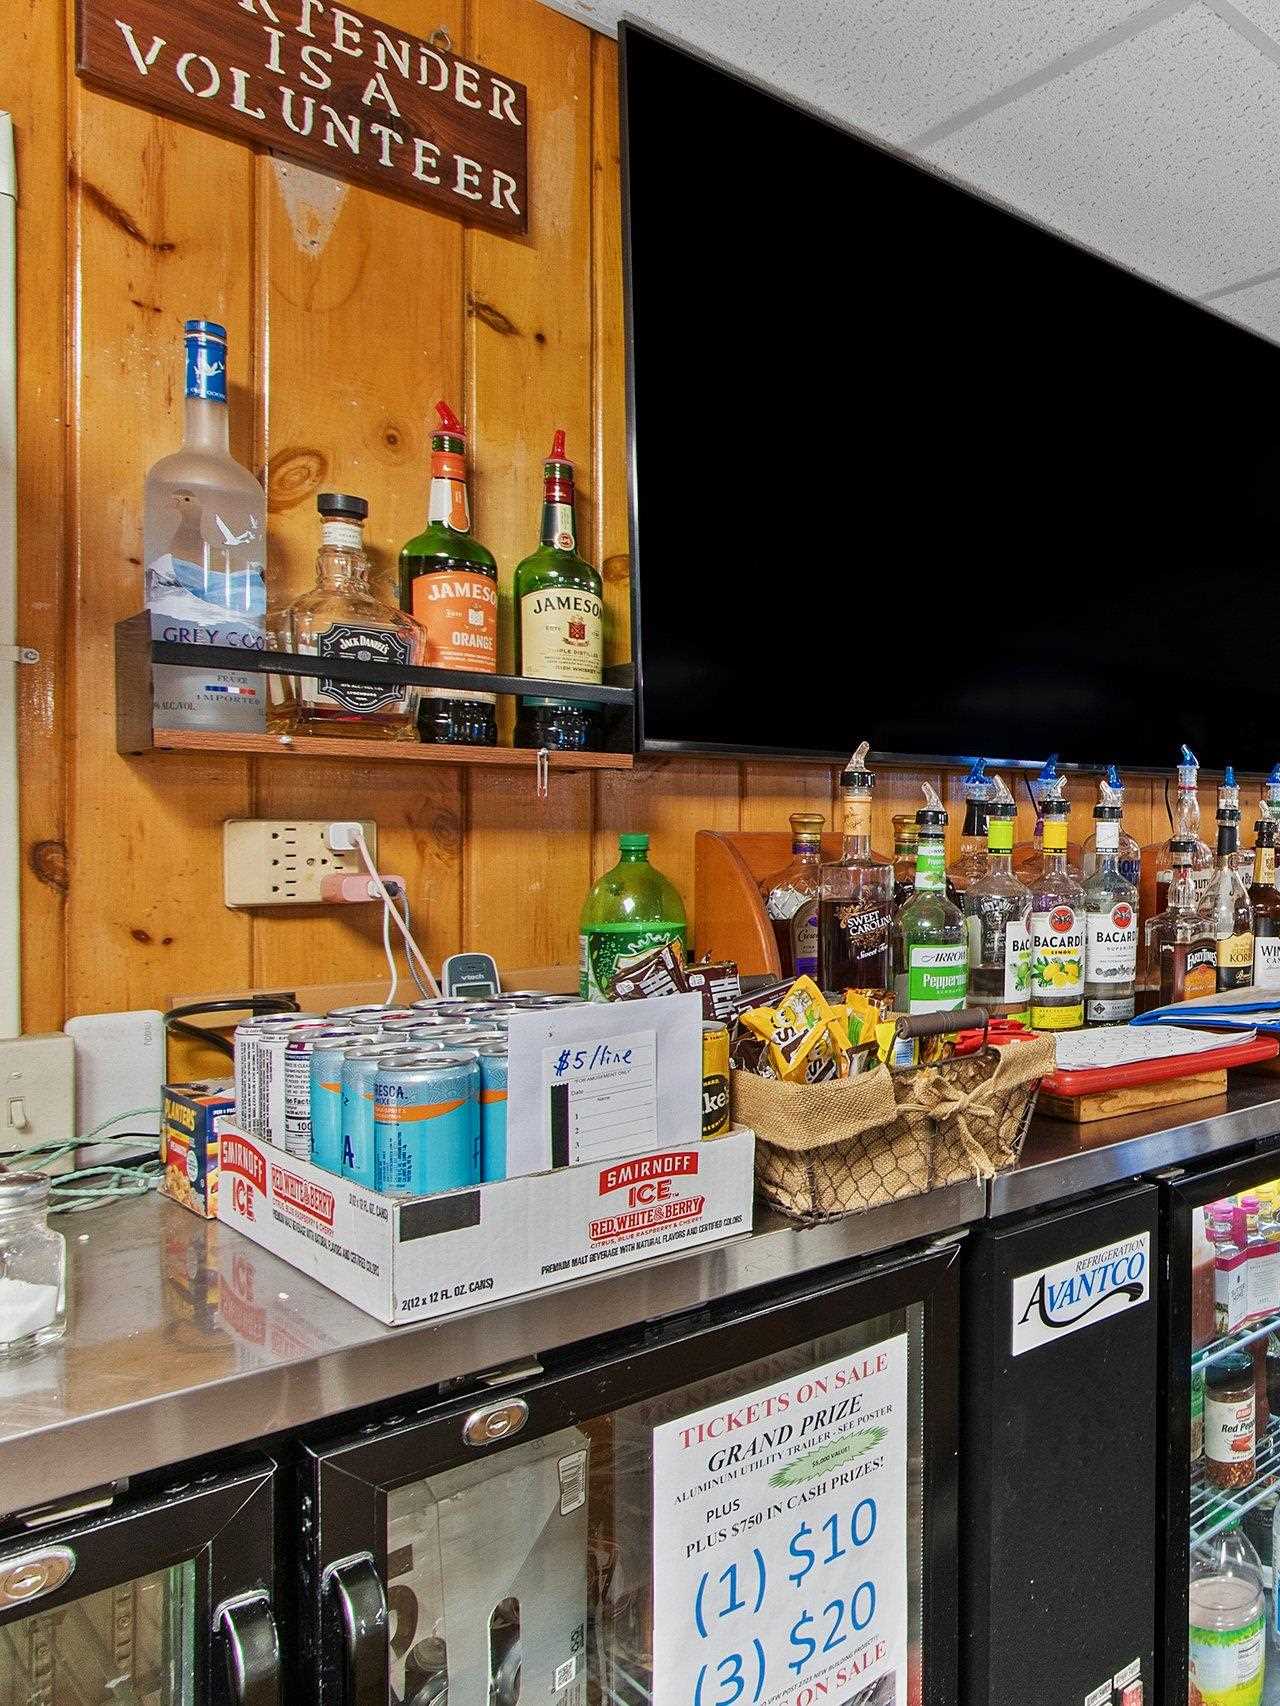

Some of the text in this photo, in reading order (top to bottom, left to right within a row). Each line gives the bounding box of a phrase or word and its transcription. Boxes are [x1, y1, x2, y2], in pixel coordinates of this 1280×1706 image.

[263, 26, 400, 117] IS A
[115, 19, 521, 216] VOLUNTEER
[163, 626, 219, 643] GREY
[340, 636, 390, 655] JACK DANIEL'S
[452, 632, 493, 650] ORANGE
[848, 912, 880, 927] SWEET
[1034, 931, 1083, 948] BACARDÍ
[223, 1141, 263, 1184] SMIRNOFF
[607, 1156, 691, 1187] SMIRNOFF
[232, 1177, 257, 1222] ICE
[628, 1179, 672, 1208] ICE
[616, 1210, 655, 1231] WHITE
[665, 1198, 702, 1217] BERRY
[636, 1224, 673, 1238] RASPBERRY
[541, 1213, 743, 1275] PREMIUM MALT BEVERAGE WITH NATURAL FLAVORS AND CERTIFIED COLORS
[1075, 1238, 1146, 1272] REFRIGERATION
[429, 1292, 438, 1303] 12
[440, 1289, 453, 1300] FL.
[454, 1285, 468, 1297] OZ.
[469, 1277, 494, 1294] CANS)
[1018, 1252, 1145, 1328] AVANTCO
[679, 1352, 889, 1450] TICKETS ON SALE
[708, 1393, 864, 1473] GRAND PRIZE
[1221, 1424, 1239, 1433] Red
[673, 1470, 738, 1505] ALUMINUM
[740, 1451, 785, 1476] UTILITY
[786, 1431, 831, 1457] TRAILER
[837, 1420, 856, 1435] SEE
[856, 1404, 893, 1426] POSTER
[686, 1456, 885, 1558] PLUS $750 IN CASH PRIZES!
[706, 1498, 741, 1524] PLUS
[694, 1498, 878, 1639] (1) $10
[694, 1581, 877, 1706] (3) $20
[836, 1640, 887, 1688] SALE
